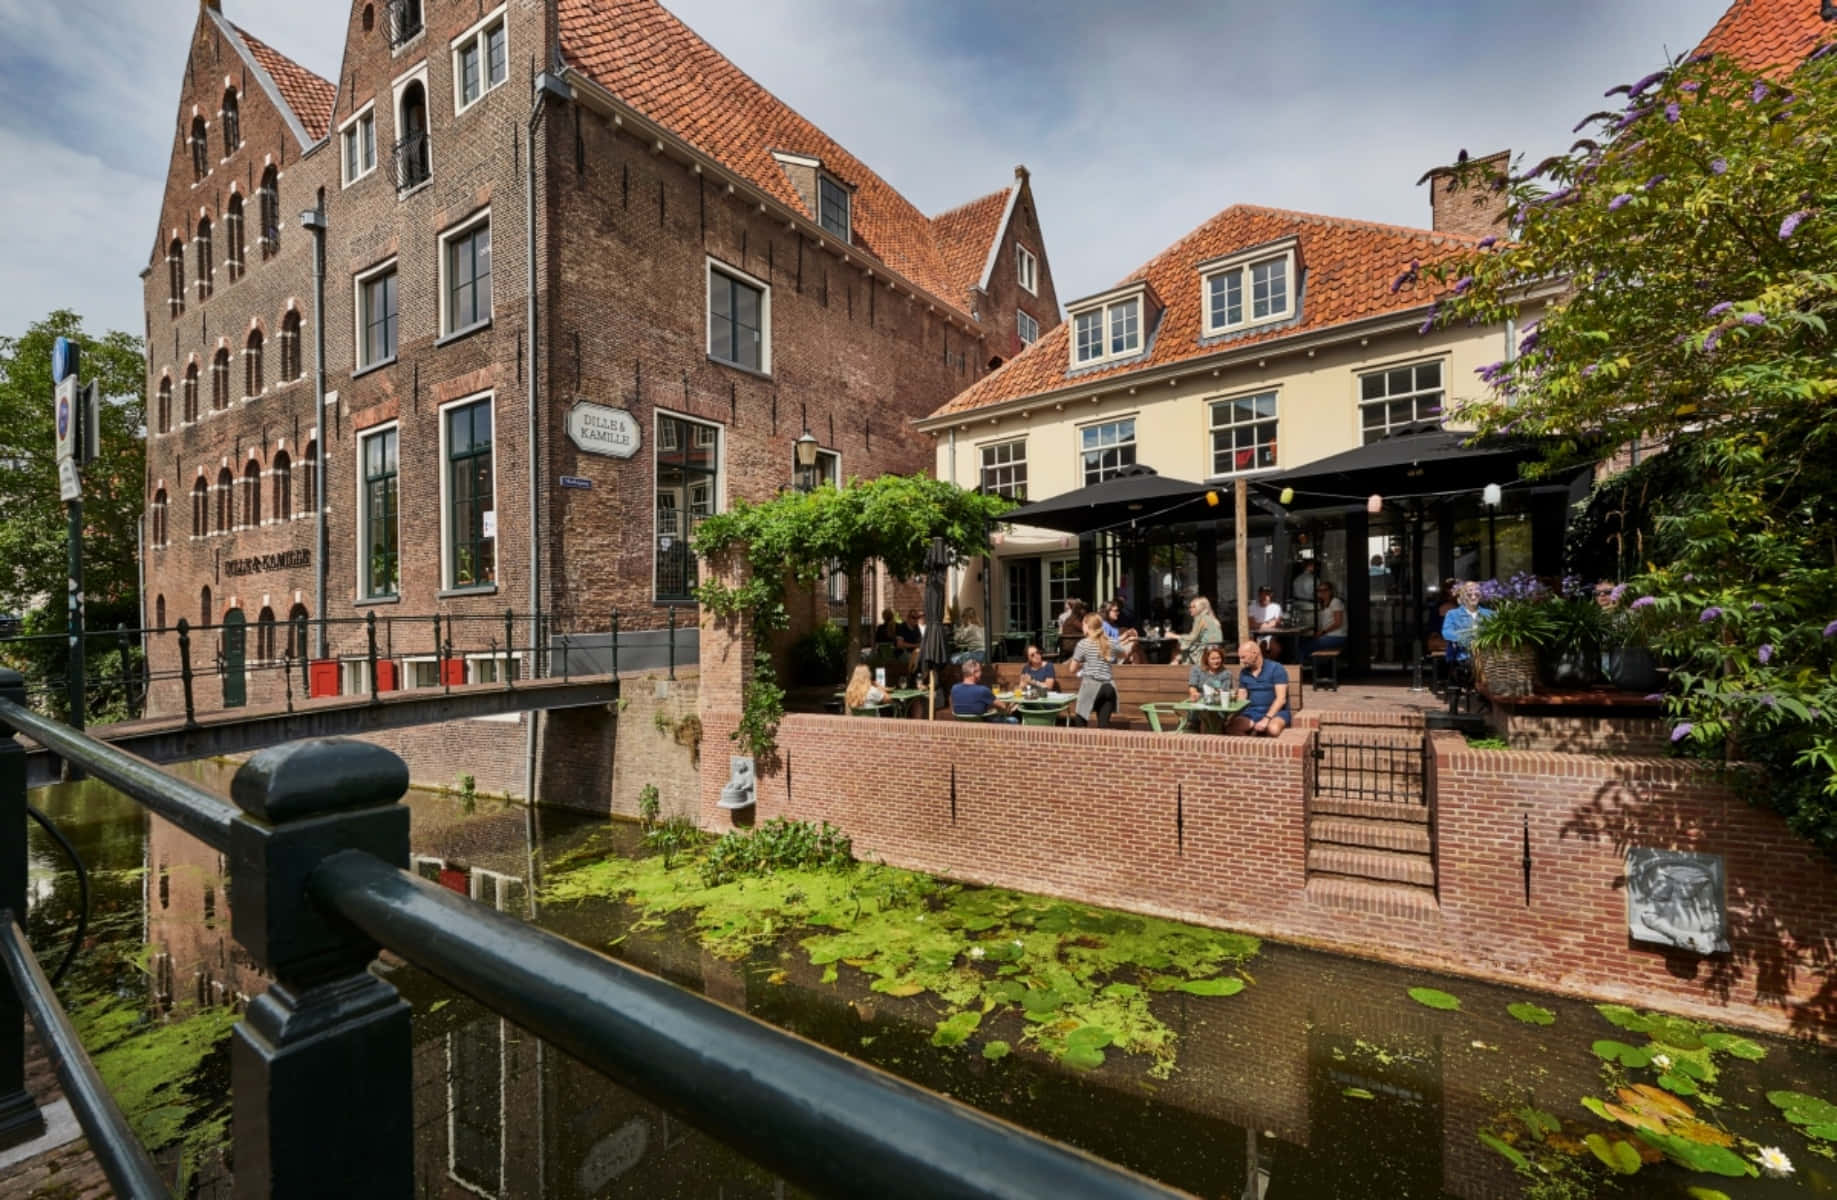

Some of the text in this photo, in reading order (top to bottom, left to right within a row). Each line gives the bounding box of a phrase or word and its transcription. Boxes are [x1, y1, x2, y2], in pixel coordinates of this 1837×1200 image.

[583, 414, 626, 433] DILLE &
[580, 428, 630, 446] KAMILLE
